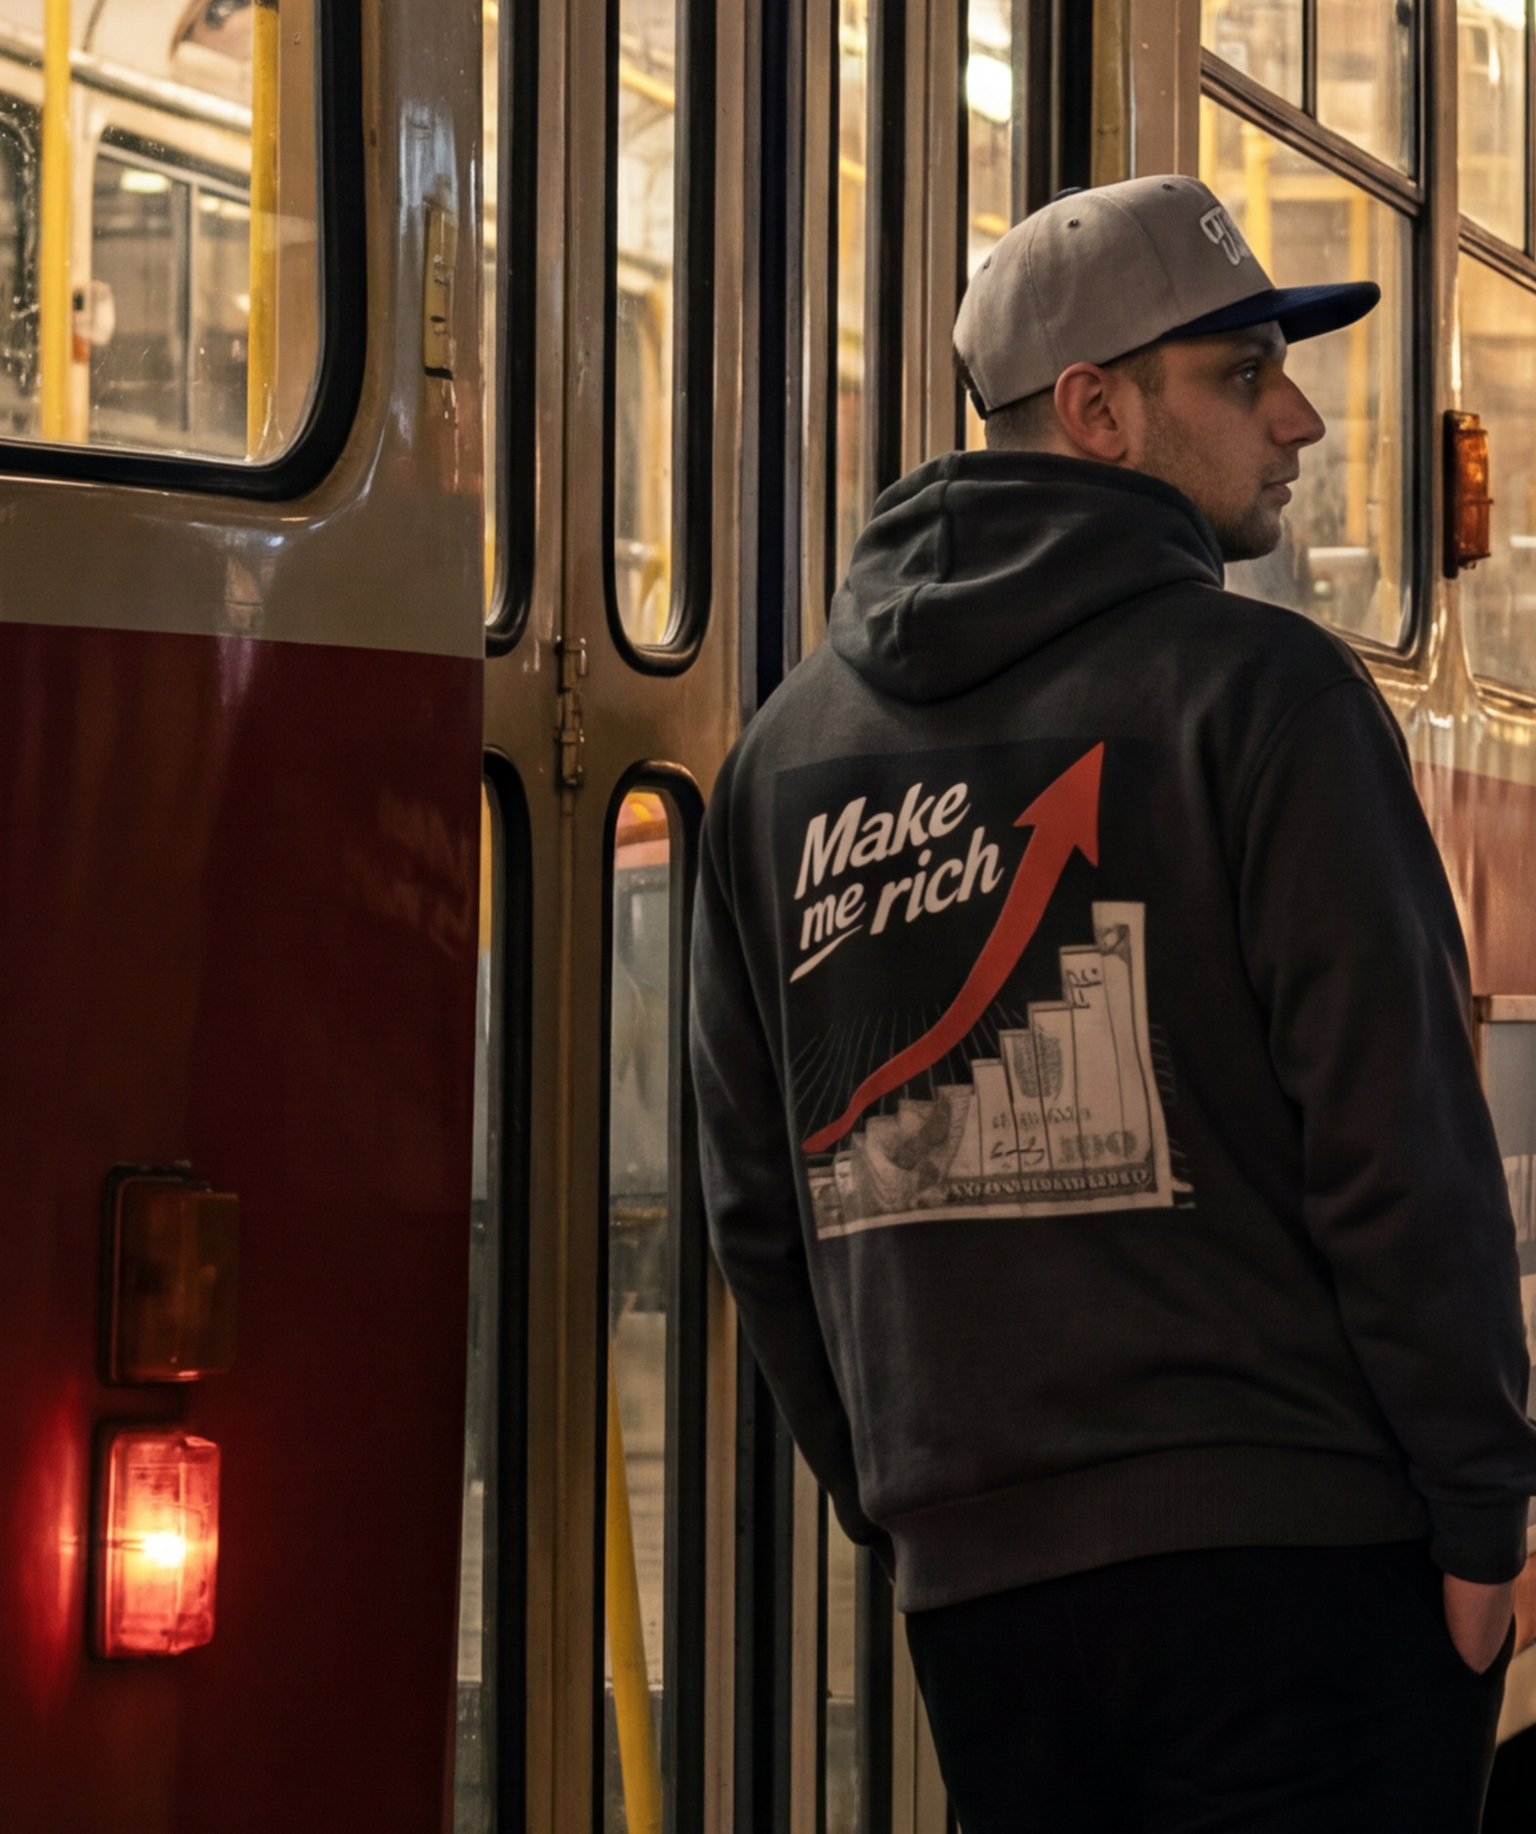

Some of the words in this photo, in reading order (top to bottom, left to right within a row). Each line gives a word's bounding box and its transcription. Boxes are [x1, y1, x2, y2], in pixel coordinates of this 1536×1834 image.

[794, 782, 972, 900] Make
[800, 882, 867, 951] me
[869, 825, 1005, 936] rich
